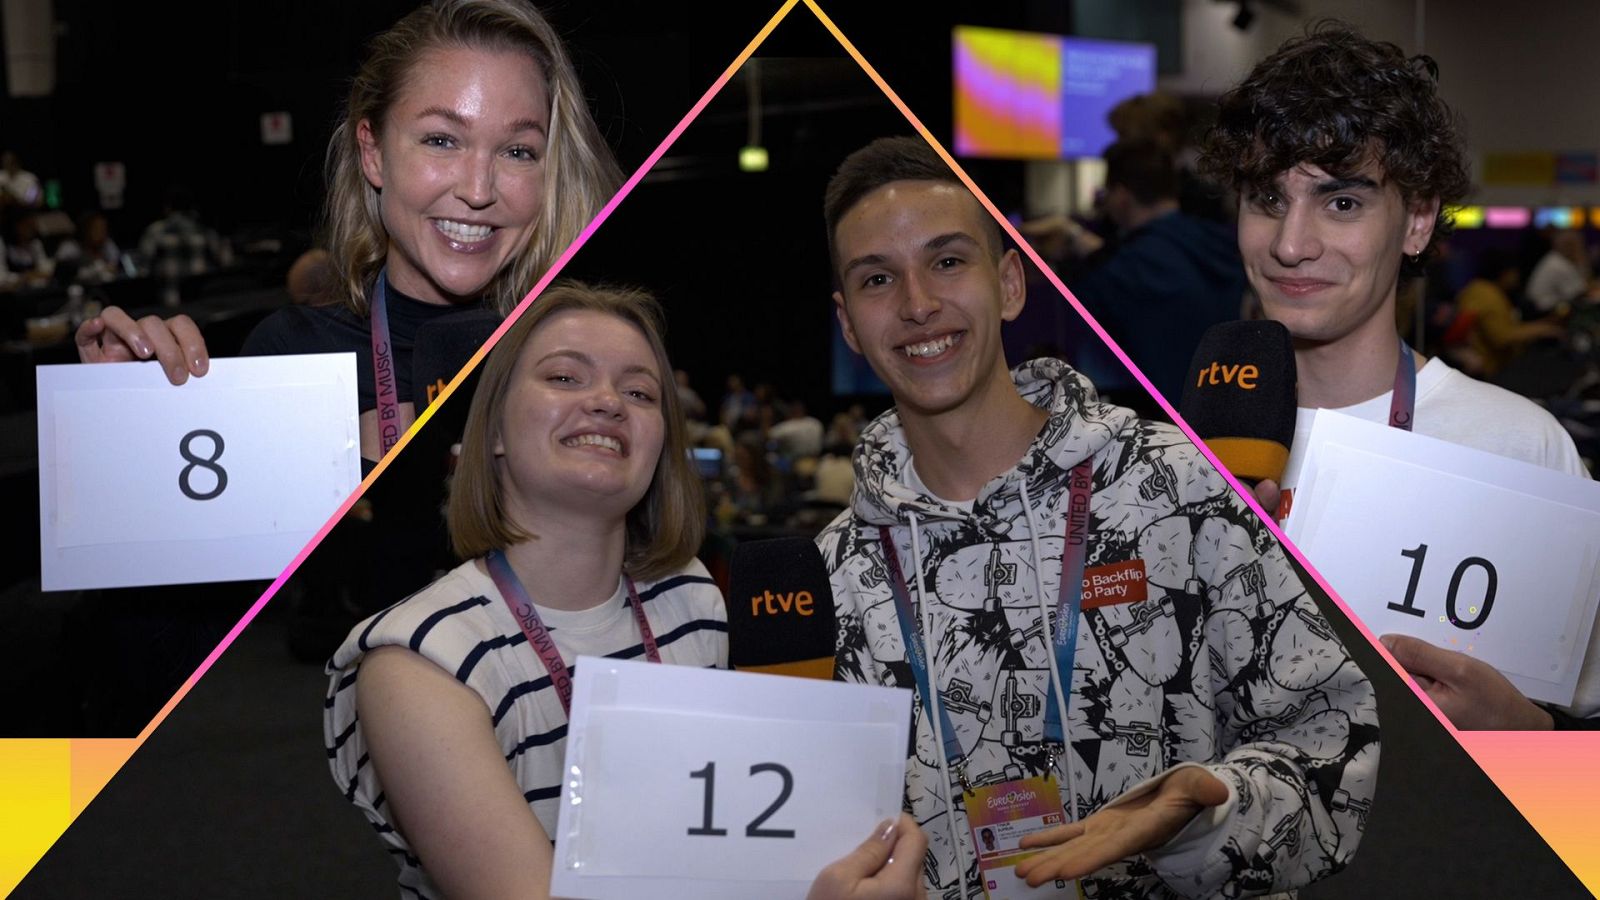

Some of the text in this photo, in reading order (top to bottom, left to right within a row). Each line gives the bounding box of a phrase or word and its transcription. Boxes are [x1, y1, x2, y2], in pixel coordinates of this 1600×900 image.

[375, 341, 393, 397] MUSIC
[1197, 361, 1259, 389] rtve
[381, 402, 396, 420] BY
[178, 428, 229, 501] 8
[1074, 471, 1088, 489] BY
[1068, 495, 1087, 546] UNITED
[1081, 569, 1143, 588] o Backflip
[1094, 584, 1128, 597] Party
[1386, 543, 1498, 630] 10
[752, 590, 814, 616] rtve
[516, 603, 553, 654] MUSIC
[544, 655, 563, 674] BY
[686, 761, 796, 838] 12
